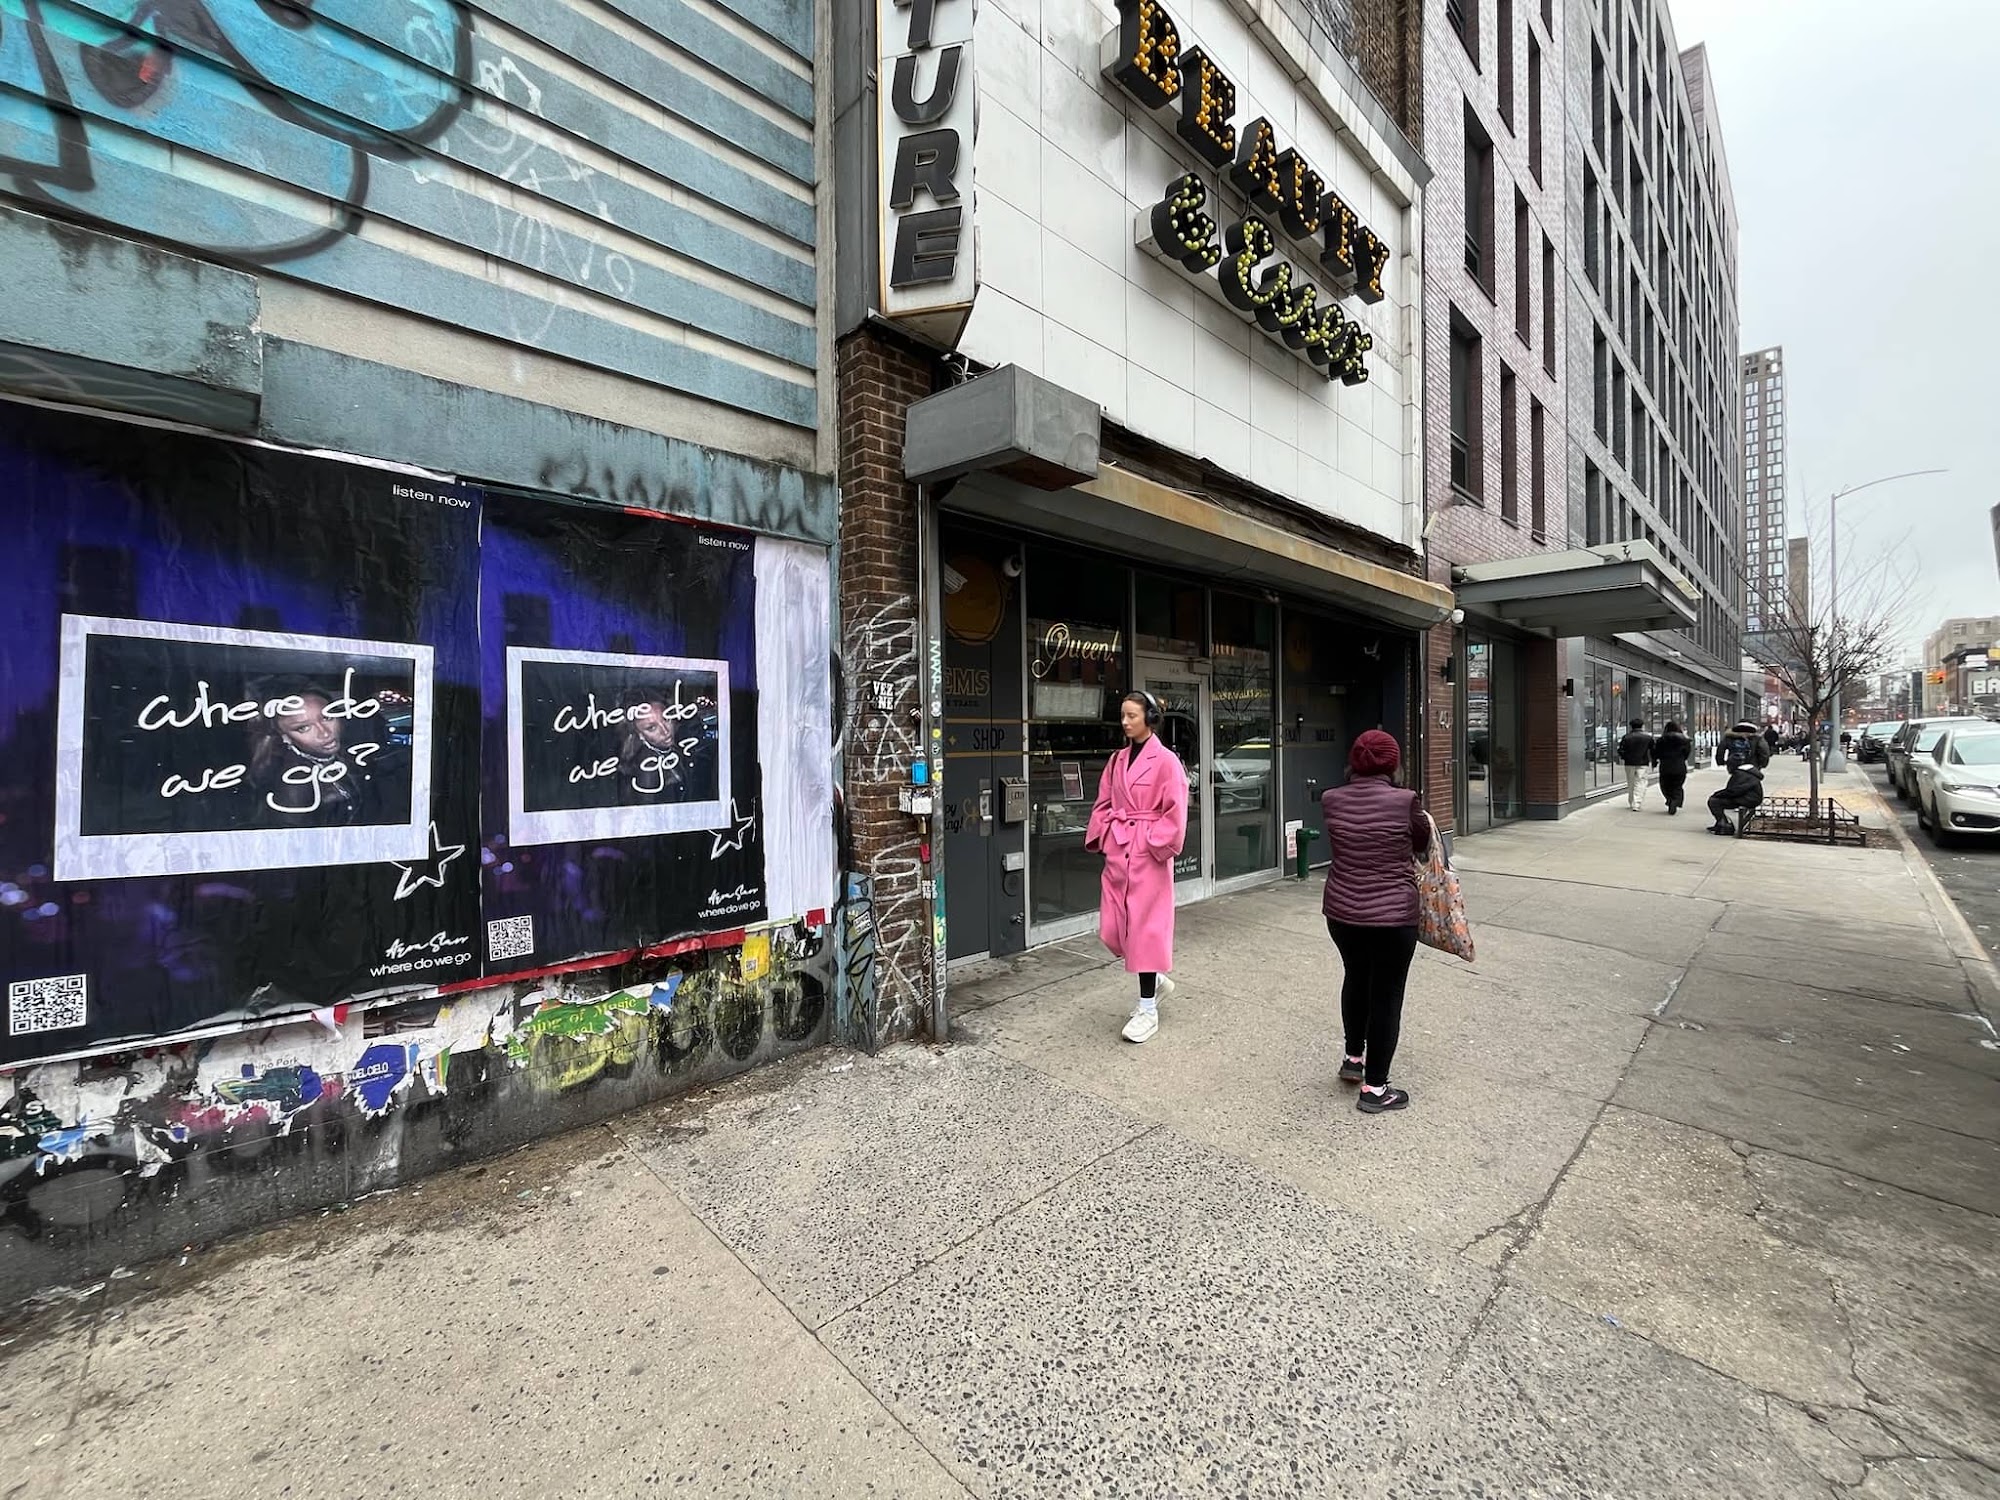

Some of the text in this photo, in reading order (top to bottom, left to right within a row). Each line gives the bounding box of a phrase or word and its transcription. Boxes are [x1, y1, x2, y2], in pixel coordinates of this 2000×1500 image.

[1114, 0, 1390, 305] BEAUTY
[392, 484, 472, 509] listen now
[698, 535, 751, 551] listen now
[322, 667, 381, 720] do
[662, 680, 698, 720] do
[973, 728, 1005, 750] SHOP
[161, 742, 381, 813] we go?
[569, 737, 699, 793] we go?
[698, 900, 761, 919] where do we go
[370, 952, 472, 977] where do we go
[569, 1008, 588, 1024] of
